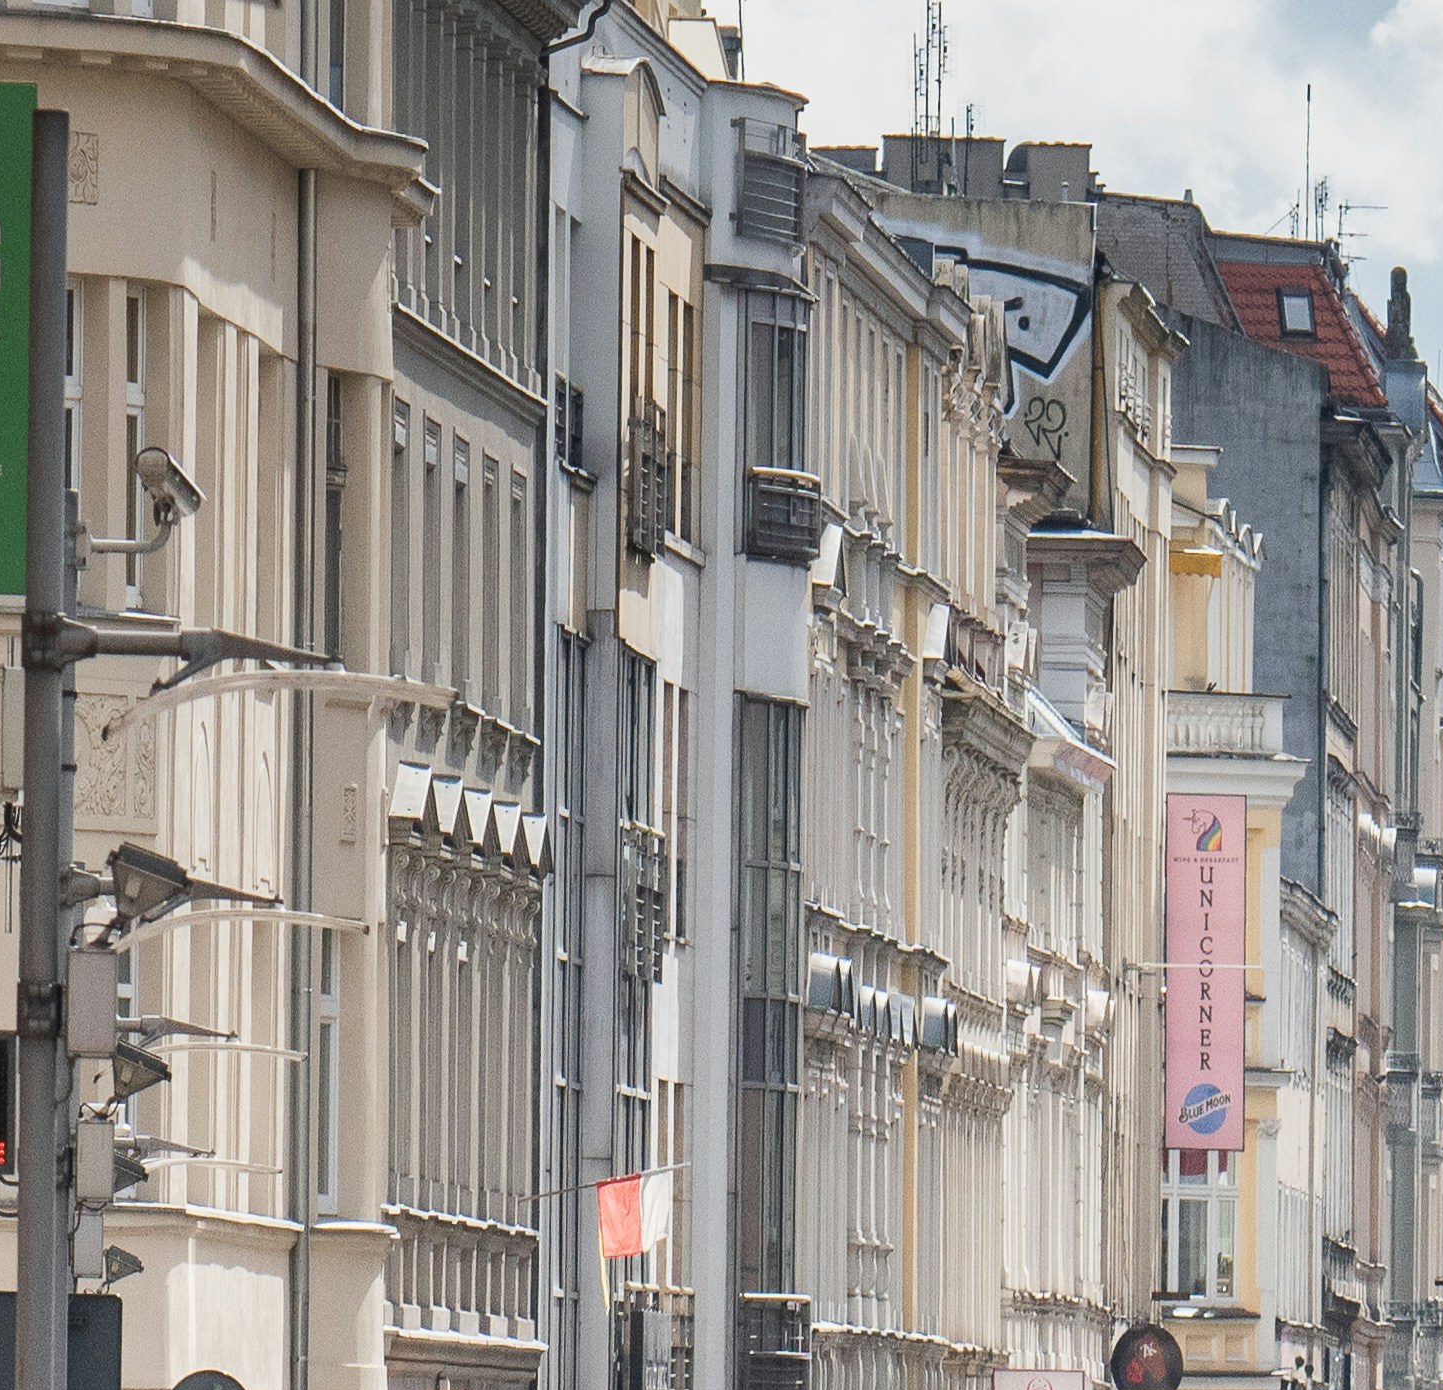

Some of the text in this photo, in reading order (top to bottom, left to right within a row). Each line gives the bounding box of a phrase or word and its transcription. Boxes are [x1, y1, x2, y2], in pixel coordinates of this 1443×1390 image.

[1199, 865, 1214, 1072] UNICORNER
[1178, 1093, 1231, 1123] BLUE MOON
